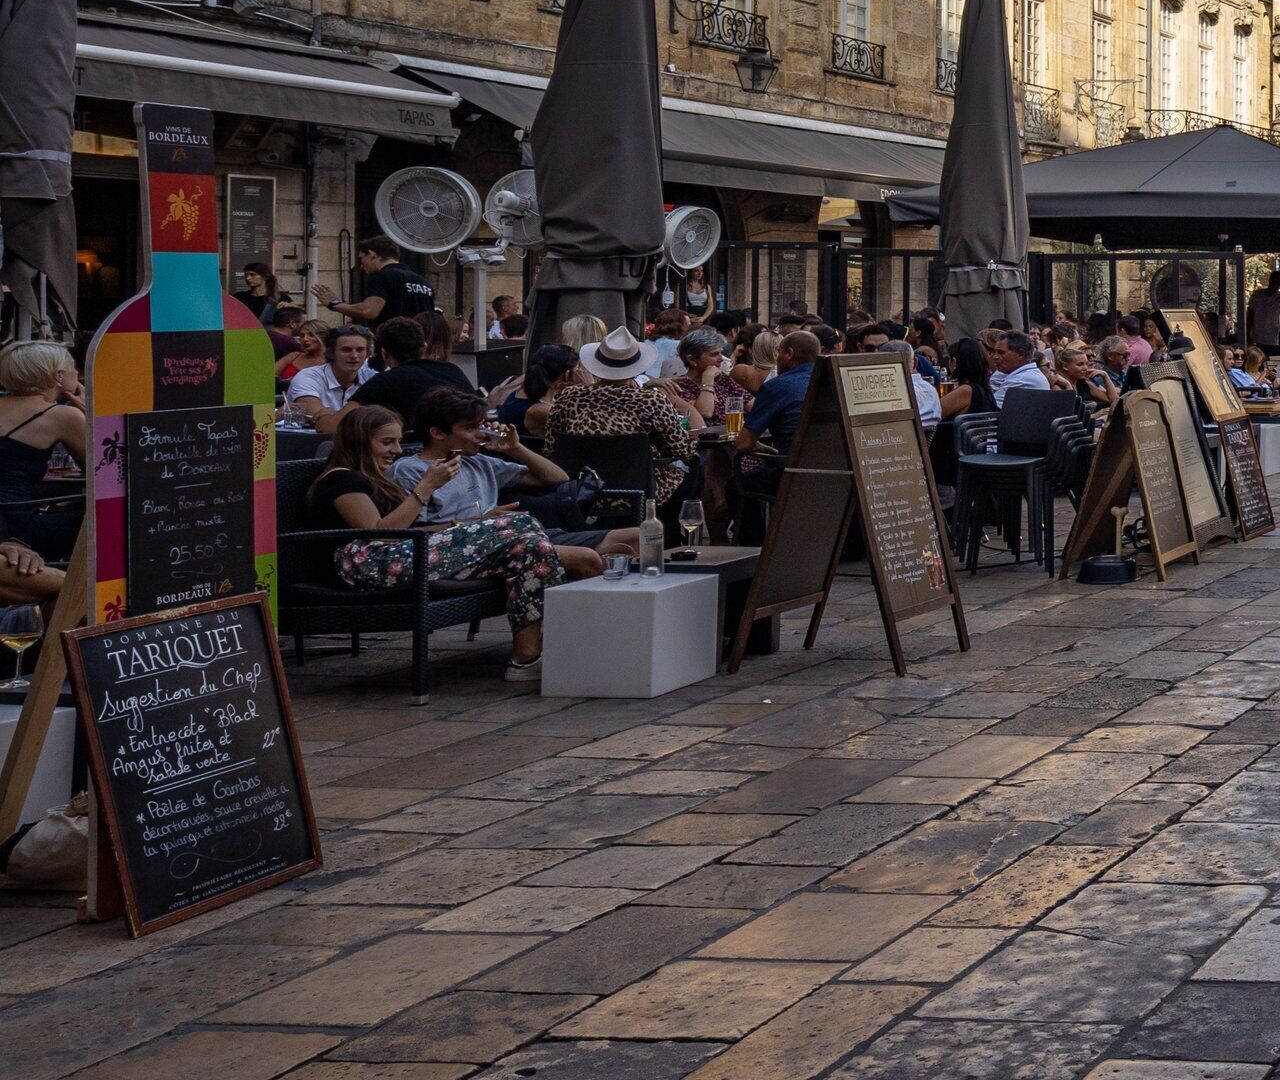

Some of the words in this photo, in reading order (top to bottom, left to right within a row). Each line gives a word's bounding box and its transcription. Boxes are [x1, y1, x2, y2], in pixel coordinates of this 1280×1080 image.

[398, 109, 435, 126] TAPAS
[148, 130, 209, 146] BORDEAUX
[406, 282, 433, 297] STAFF
[163, 357, 205, 369] Bordeaux
[138, 423, 196, 447] Formule
[197, 419, 239, 444] Tapas
[205, 443, 218, 457] de
[160, 464, 175, 479] de
[156, 587, 213, 605] BORDEAUX
[103, 619, 203, 648] DOMAINE
[217, 611, 240, 625] DU
[106, 624, 244, 680] TARIQUET
[200, 669, 219, 694] du
[222, 662, 262, 694] Chef
[219, 729, 233, 746] et
[196, 748, 232, 769] verte
[192, 792, 206, 807] de
[212, 774, 262, 800] Gambas
[214, 802, 242, 819] sauce
